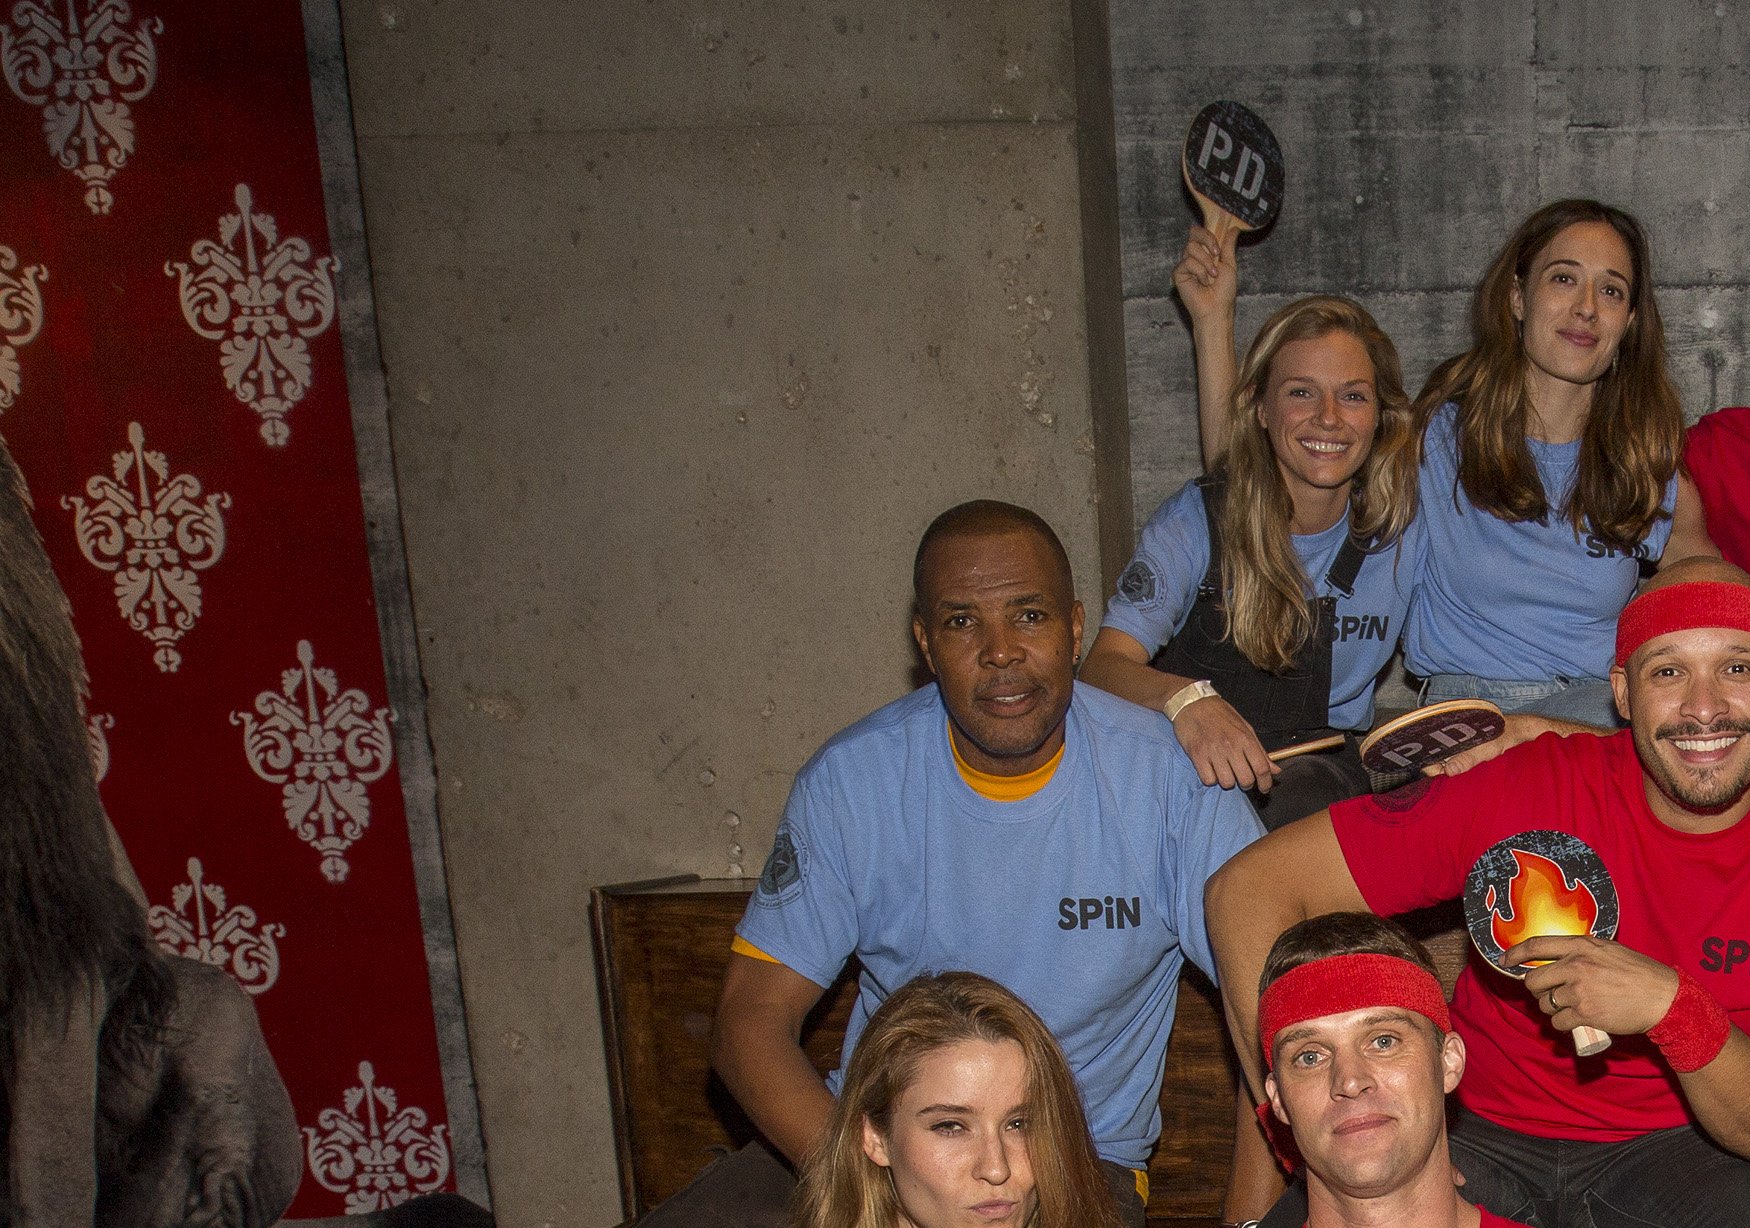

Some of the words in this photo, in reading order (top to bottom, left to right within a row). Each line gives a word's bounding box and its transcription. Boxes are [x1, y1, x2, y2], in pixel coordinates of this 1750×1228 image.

[1197, 121, 1268, 211] P.D.
[1382, 723, 1495, 767] P.D.
[1057, 895, 1141, 931] SPiN
